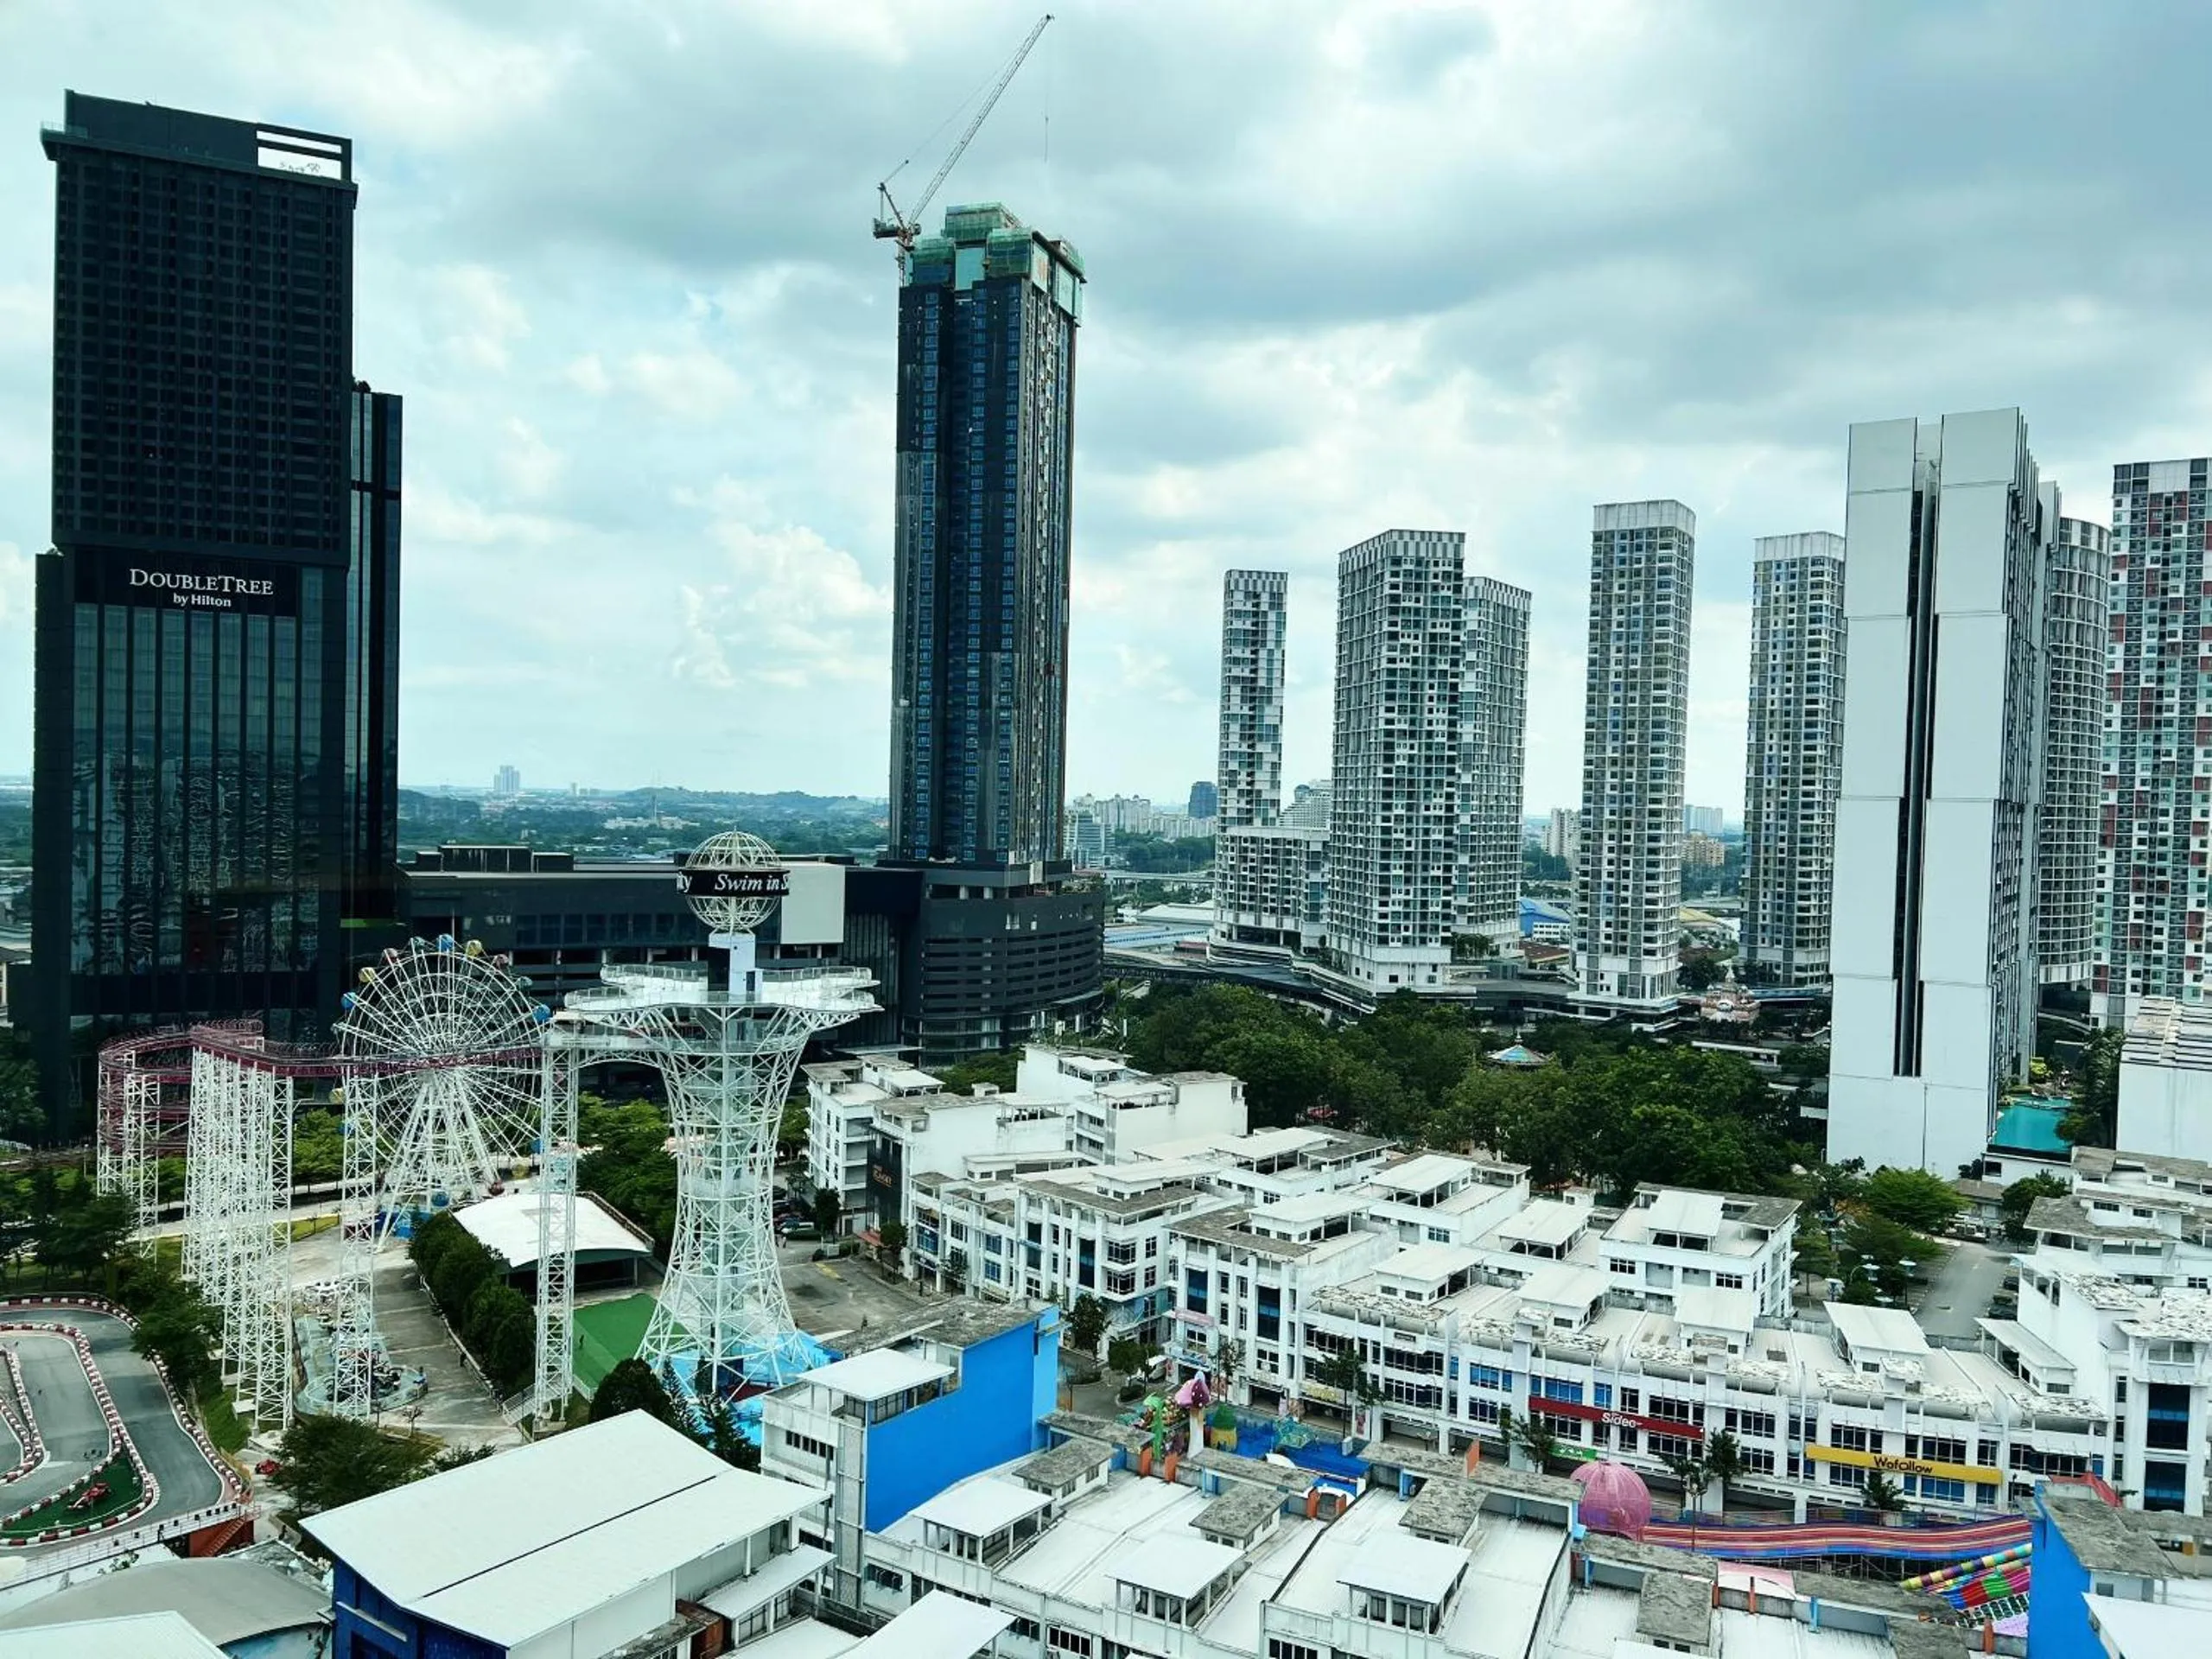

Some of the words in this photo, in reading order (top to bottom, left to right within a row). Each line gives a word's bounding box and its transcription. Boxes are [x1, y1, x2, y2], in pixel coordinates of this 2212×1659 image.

[173, 593, 187, 607] by
[191, 594, 232, 607] Hilton
[715, 874, 763, 891] Swim
[766, 874, 779, 891] in
